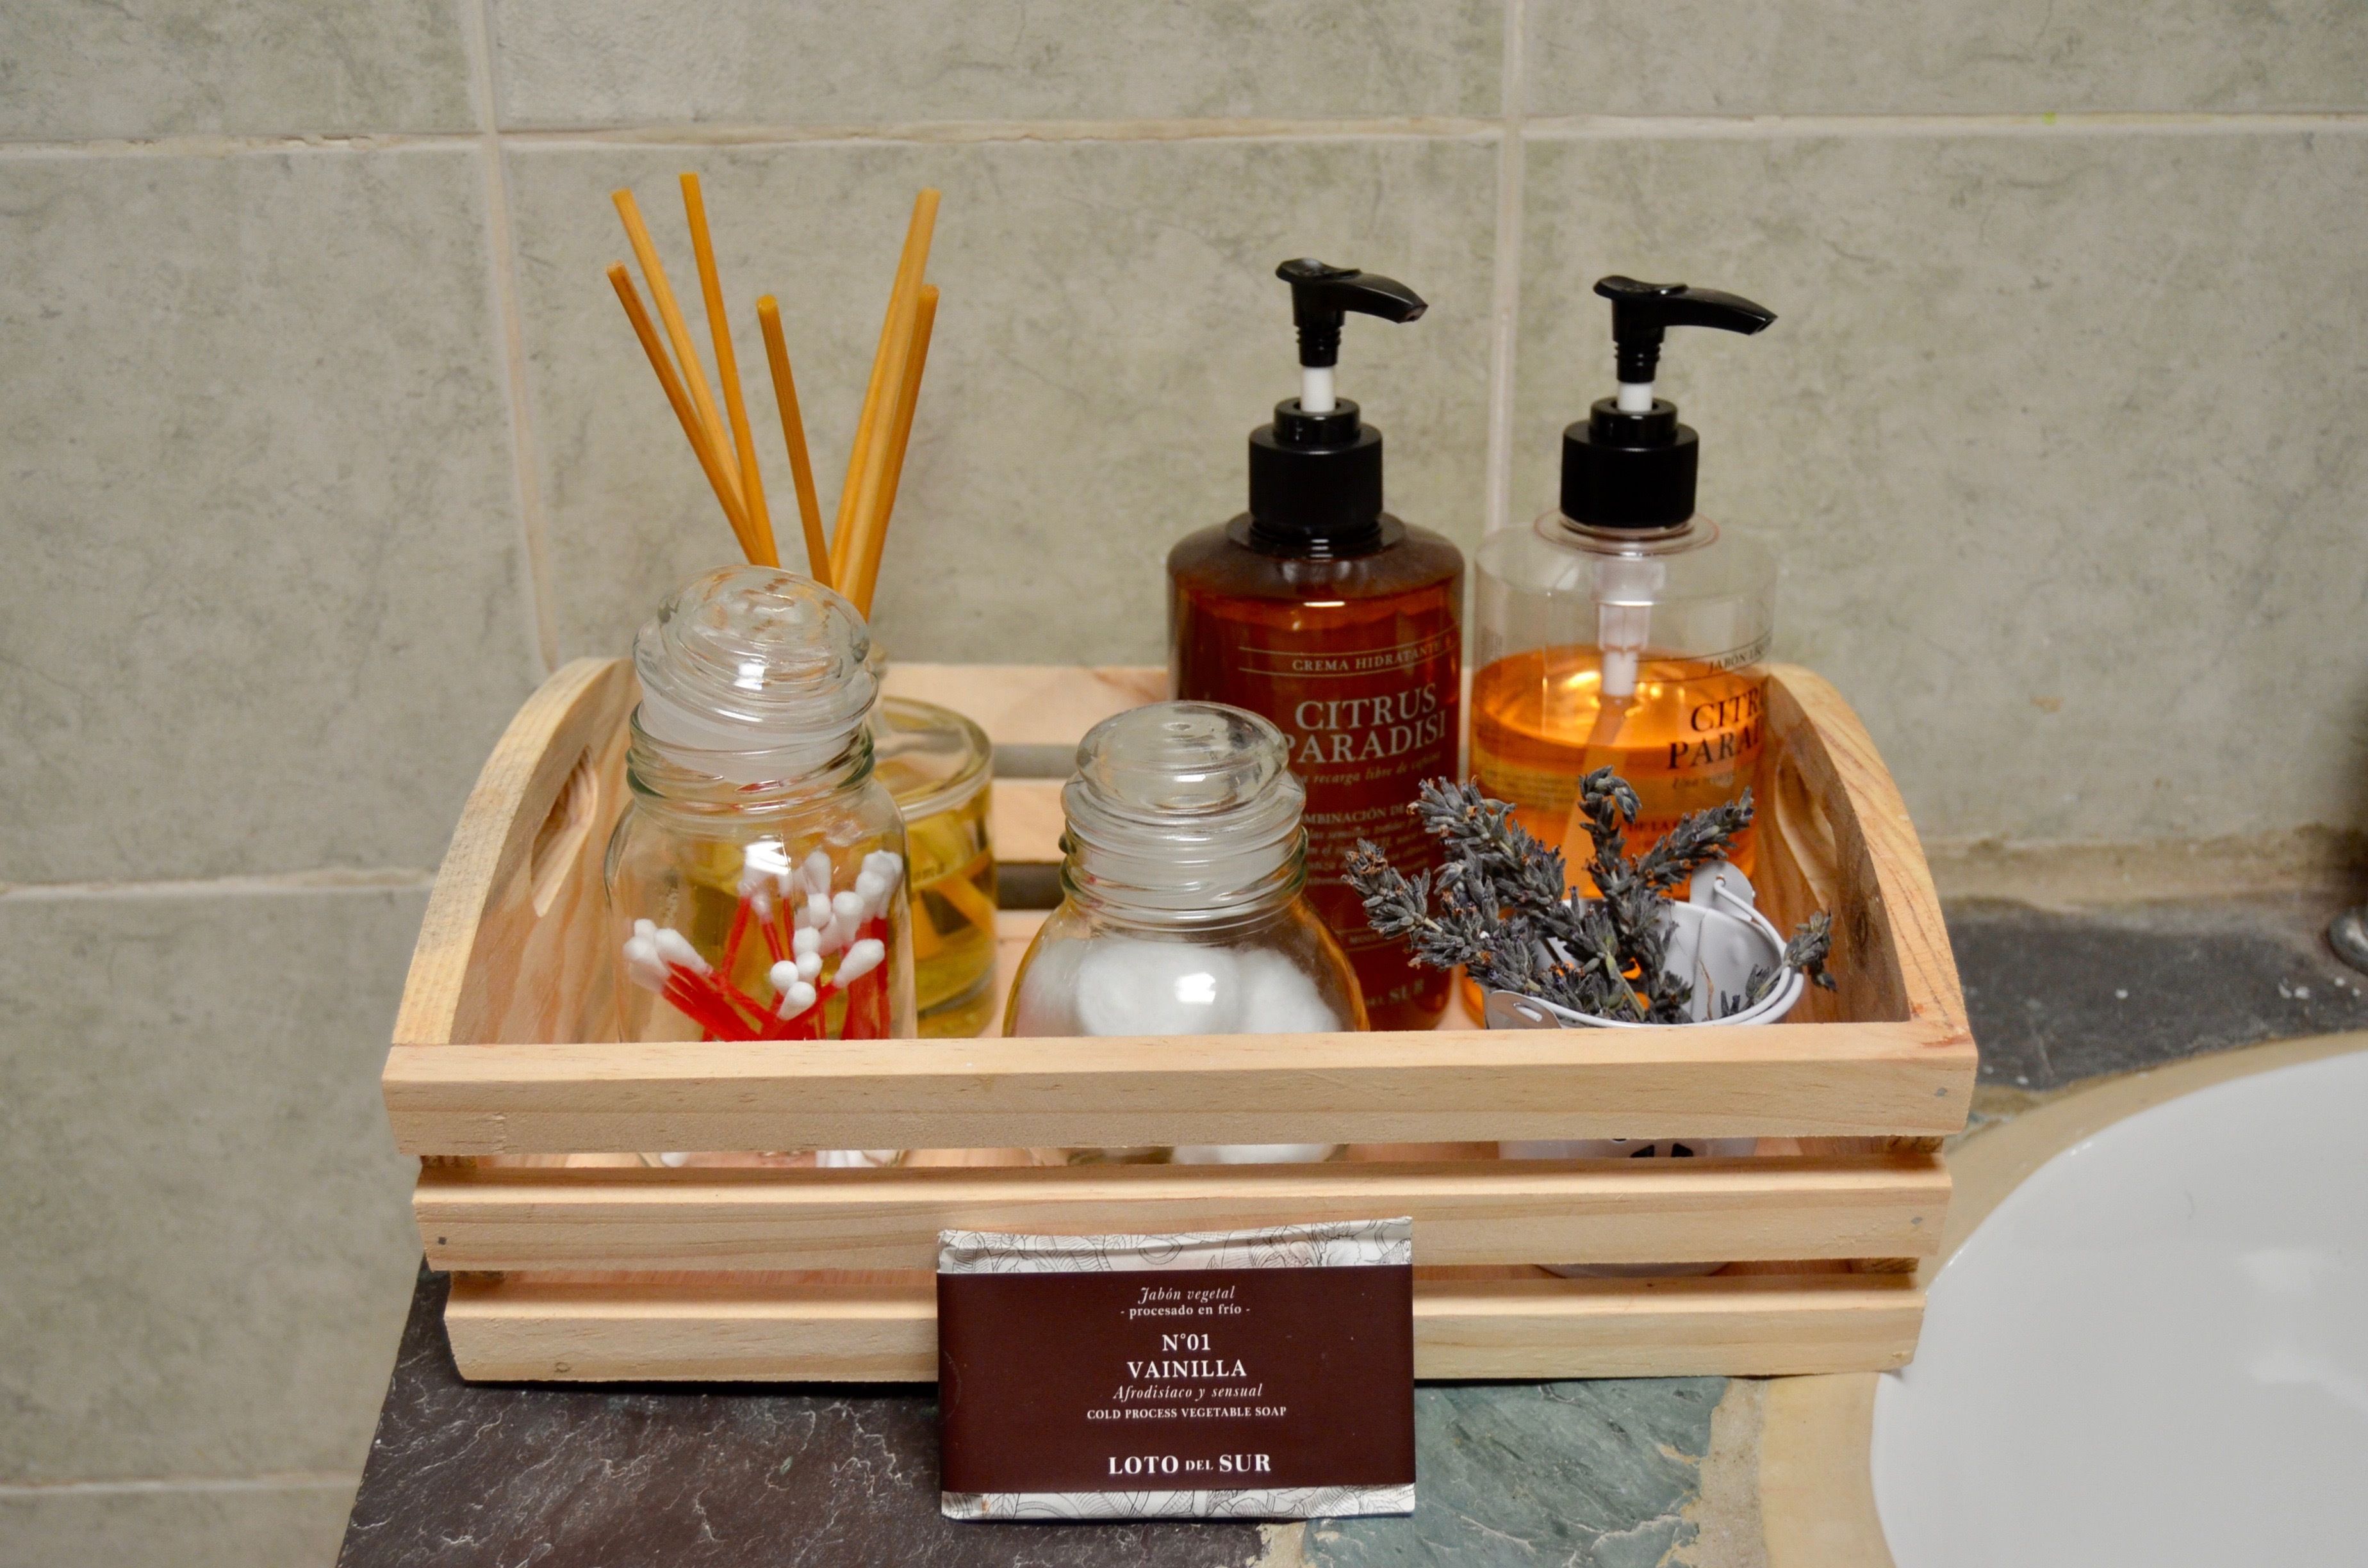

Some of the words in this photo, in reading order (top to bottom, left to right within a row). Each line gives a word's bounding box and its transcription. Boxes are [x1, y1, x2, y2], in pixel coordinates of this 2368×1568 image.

[1292, 659, 1349, 671] CREMA
[1294, 683, 1436, 731] CITRUS
[1138, 1287, 1181, 1304] Jabón
[1187, 1285, 1235, 1303] vegetal
[1129, 1304, 1194, 1319] procesado
[1197, 1307, 1213, 1315] en
[1218, 1303, 1242, 1314] frío
[1126, 1359, 1247, 1378] VAINILLA
[1112, 1384, 1193, 1403] Afrodisíaco
[1194, 1389, 1206, 1402] y
[1211, 1382, 1263, 1398] sensual
[1087, 1409, 1121, 1419] COLD
[1125, 1408, 1178, 1419] PROCESS
[1181, 1407, 1252, 1418] VEGETABLE
[1255, 1406, 1287, 1417] SOAP
[1108, 1455, 1179, 1475] LOTO
[1185, 1459, 1214, 1471] DEL
[1219, 1453, 1271, 1473] SUR
